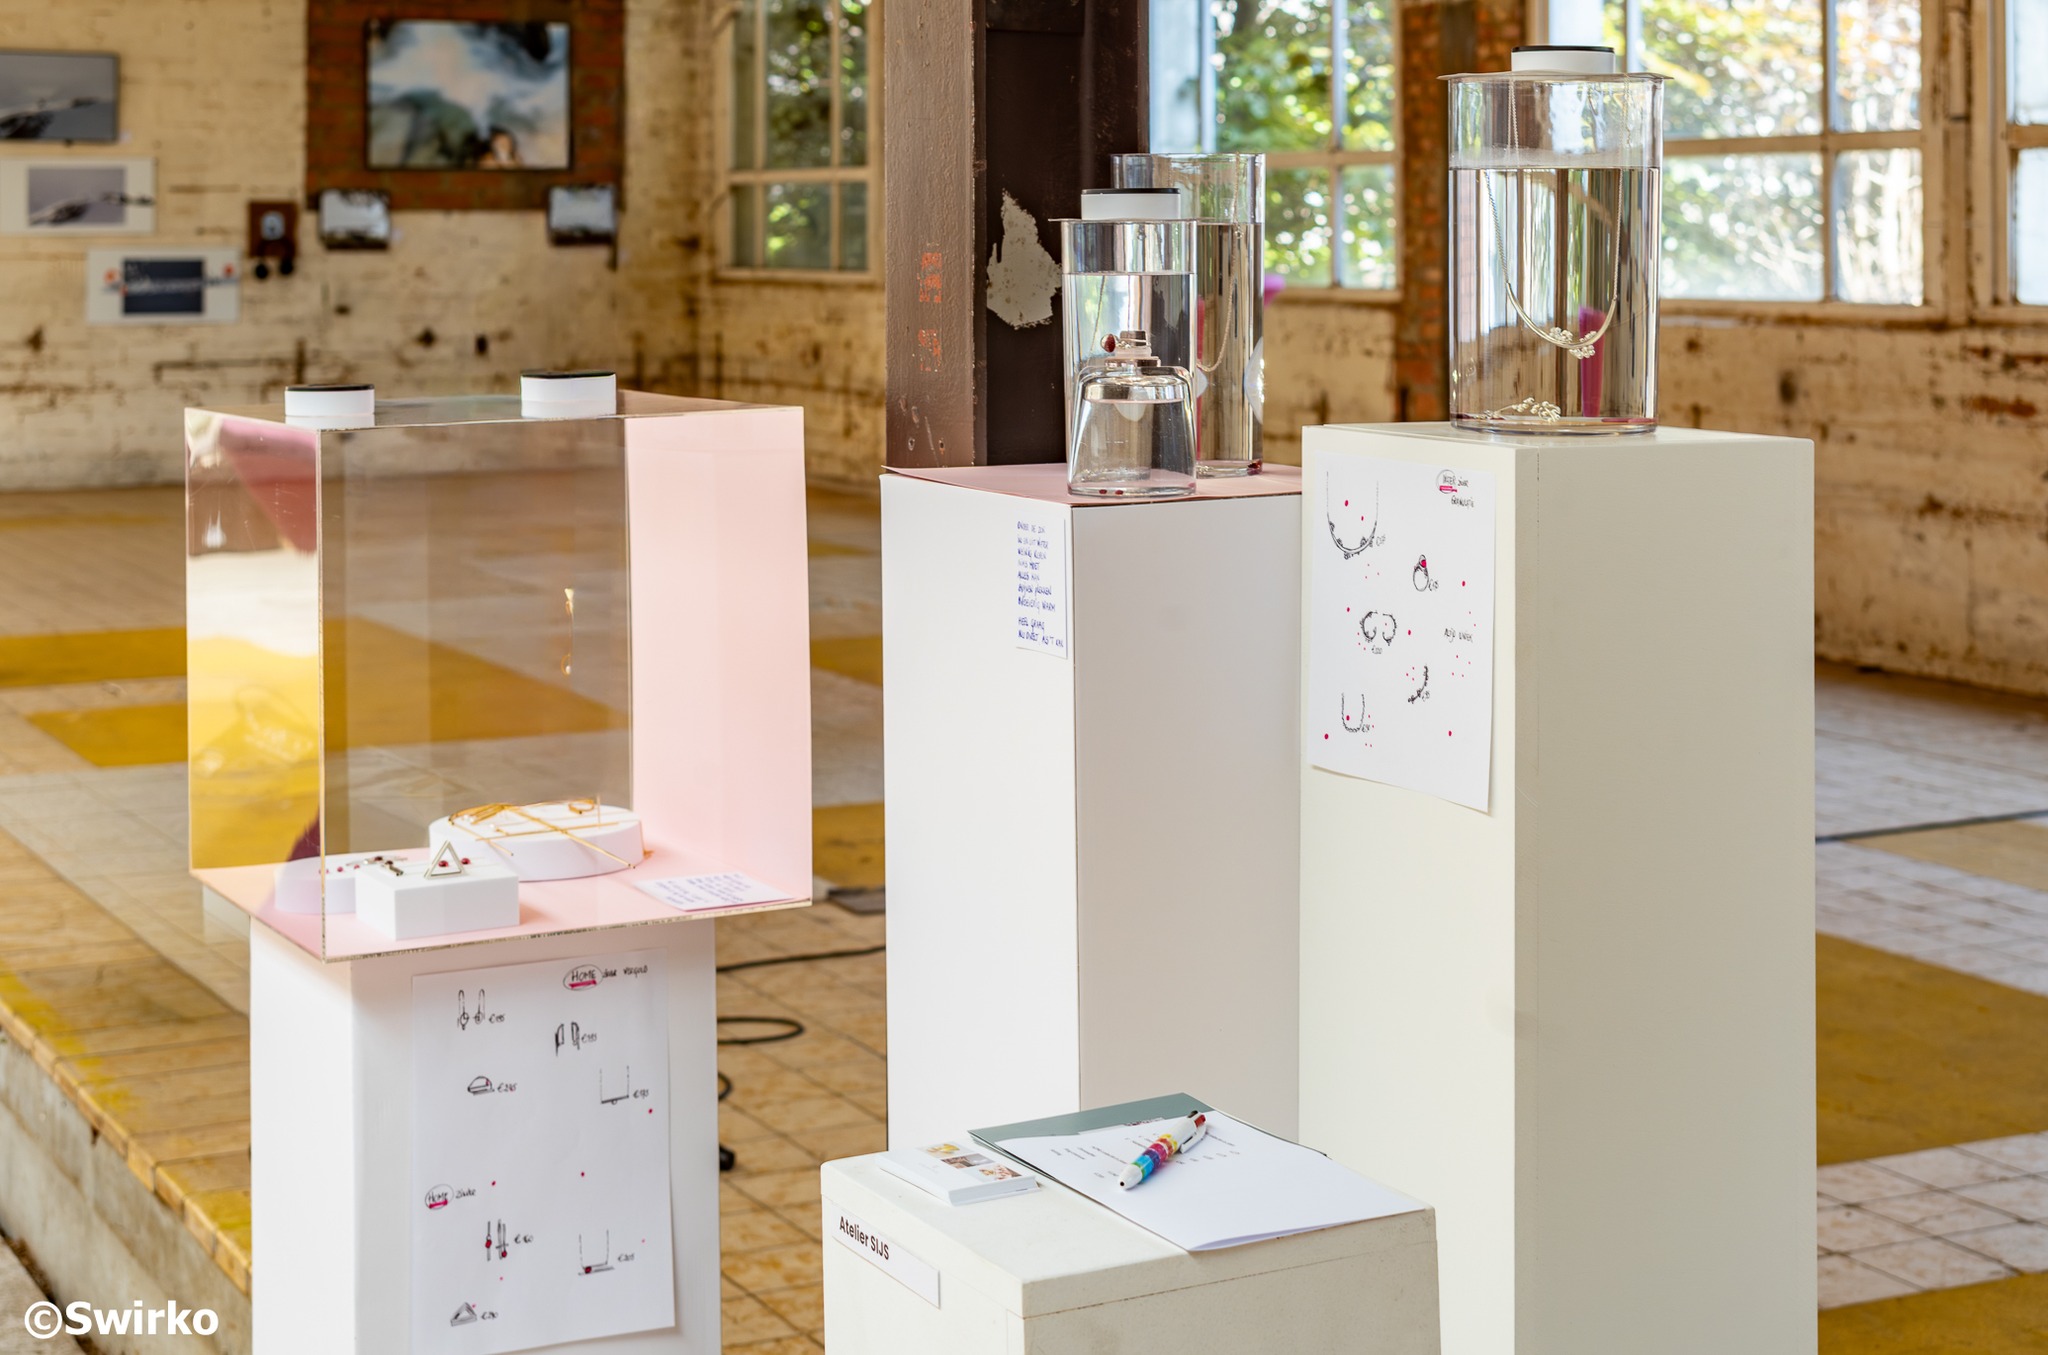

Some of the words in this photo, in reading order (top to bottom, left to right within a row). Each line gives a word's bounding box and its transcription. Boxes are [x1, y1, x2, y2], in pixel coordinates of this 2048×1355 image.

[570, 969, 597, 982] HOME
[428, 1191, 449, 1203] HOME
[840, 1215, 869, 1247] Atelier
[870, 1235, 890, 1261] SIJS
